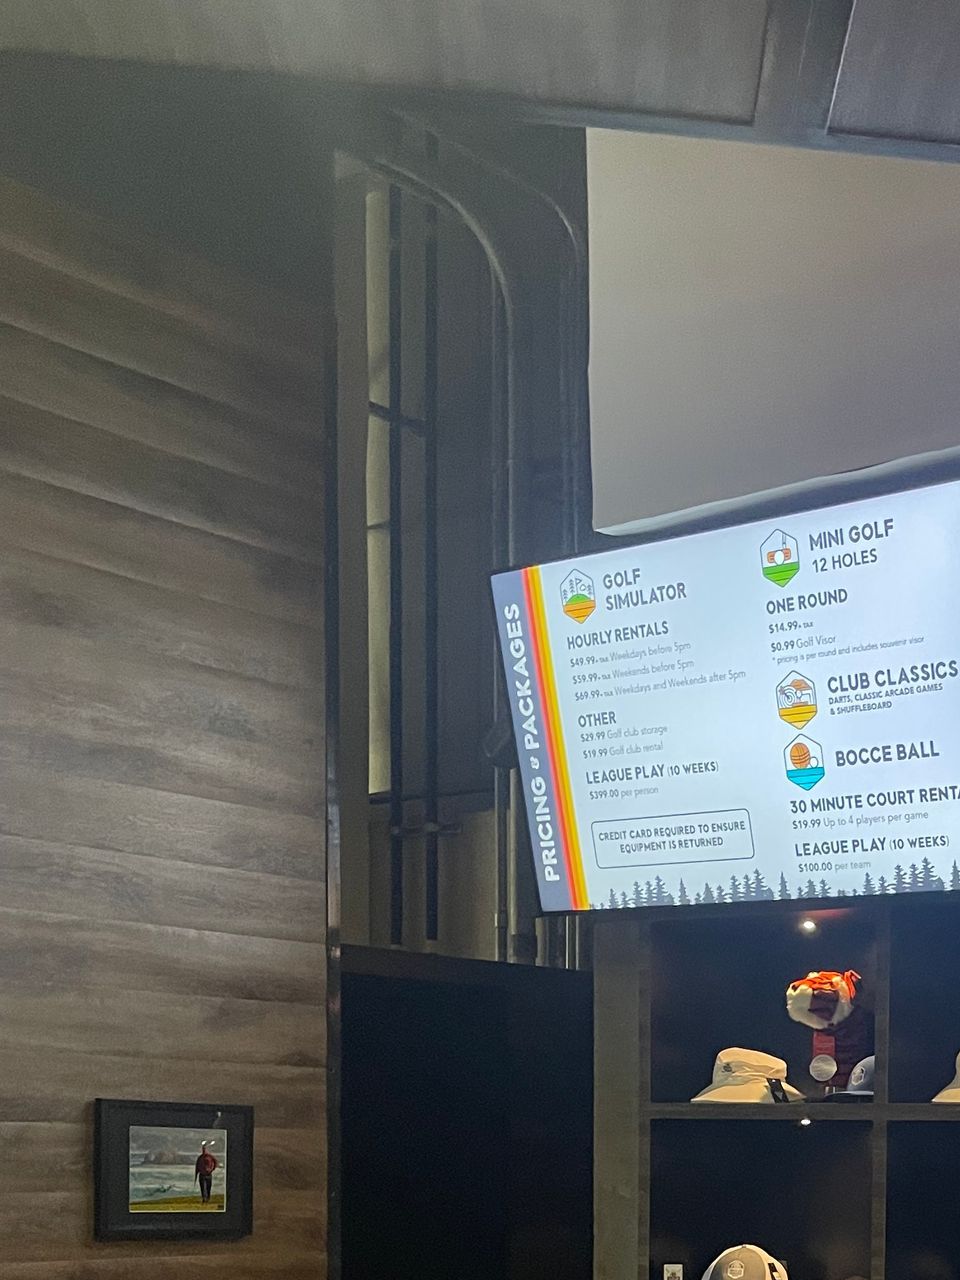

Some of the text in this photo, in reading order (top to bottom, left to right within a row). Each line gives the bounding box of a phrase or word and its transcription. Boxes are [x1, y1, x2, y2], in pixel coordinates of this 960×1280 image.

[808, 518, 895, 551] MINI GOLF
[811, 548, 878, 574] 12 HOLES
[603, 568, 641, 589] GOLF
[606, 582, 687, 611] SIMULATOR
[766, 588, 848, 615] ONE ROUND
[567, 620, 669, 650] HOURLY RENTALS
[771, 635, 836, 653] $0.99 Golf Visor
[852, 643, 879, 654] includes
[909, 636, 925, 645] visor
[609, 646, 647, 662] Weekdays
[648, 643, 673, 656] before
[674, 641, 691, 653] 5pm
[612, 665, 650, 680] Weekends
[651, 661, 676, 674] before
[677, 659, 695, 671] 5pm
[827, 659, 959, 694] CLUB CLASSICS
[614, 682, 651, 697] Weekdays
[652, 679, 667, 691] and
[667, 674, 708, 689] Weekends
[709, 671, 727, 684] after
[728, 669, 746, 682] 5pm
[829, 682, 943, 706] DARTS, CLASSIC ARCADE GAMES
[837, 700, 892, 715] SHUFFLEBOARD
[577, 711, 617, 727] OTHER
[505, 604, 560, 881] PRICING & PACKAGES
[580, 725, 668, 743] $29.99 Golf club storage
[583, 740, 664, 759] $19.99 Golf club rental
[835, 740, 940, 767] BOCCE BALL
[586, 761, 719, 784] LEAGUE PLAY (10 WEEKS)
[589, 786, 659, 800] $399.00 per person
[790, 800, 807, 814] 30
[811, 795, 863, 813] MINUTE
[866, 789, 915, 807] COURT
[598, 820, 746, 841] CREDIT CARD REQUIRED TO ENSURE
[792, 818, 821, 830] $19.99
[823, 817, 836, 829] Up
[837, 816, 847, 827] to
[856, 813, 886, 827] players
[888, 813, 902, 824] per
[904, 811, 929, 823] game
[619, 836, 724, 854] EQUIPMENT IS RETURNED
[794, 835, 950, 857] LEAGUE PLAY (10 WEEKS)
[798, 860, 872, 873] $100.00 per team
